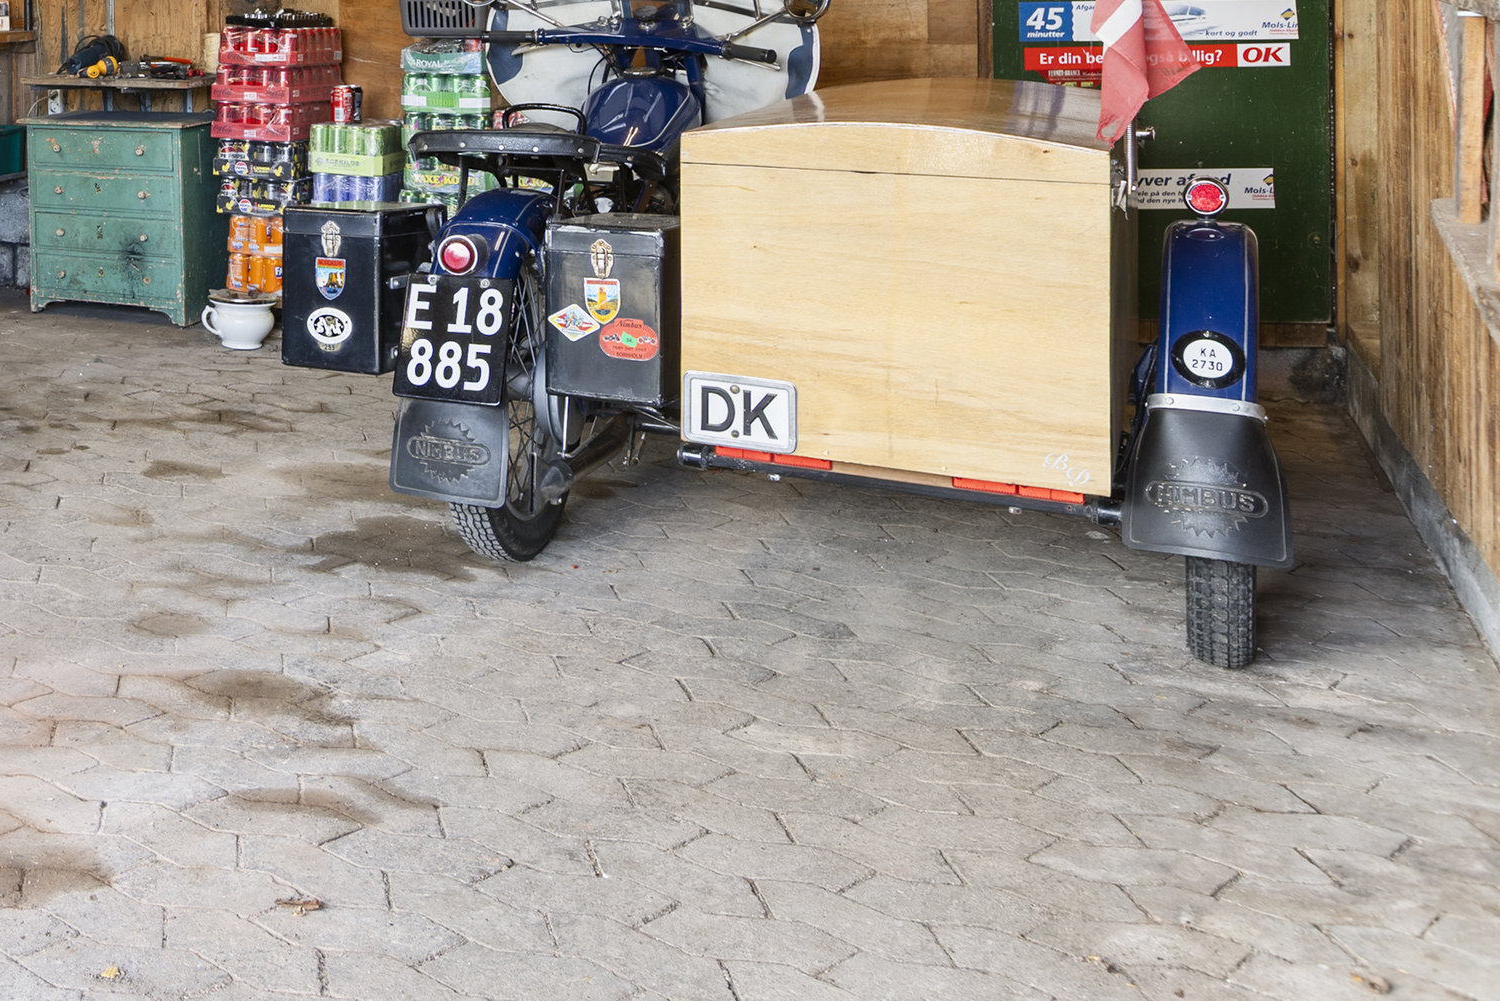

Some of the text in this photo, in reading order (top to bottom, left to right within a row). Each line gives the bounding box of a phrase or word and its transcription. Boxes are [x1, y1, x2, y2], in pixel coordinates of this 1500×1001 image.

[1026, 6, 1064, 31] 45
[1027, 30, 1065, 38] minutter
[1238, 29, 1257, 37] godt
[1039, 53, 1054, 65] Er
[1058, 52, 1081, 65] din
[1243, 46, 1284, 63] OK
[1150, 190, 1160, 198] på
[407, 283, 503, 336] E 18
[406, 338, 492, 392] 885
[1192, 359, 1224, 372] 2730
[700, 384, 779, 440] DK
[415, 440, 481, 460] NIMBUS
[1156, 484, 1255, 513] NIMBUS
